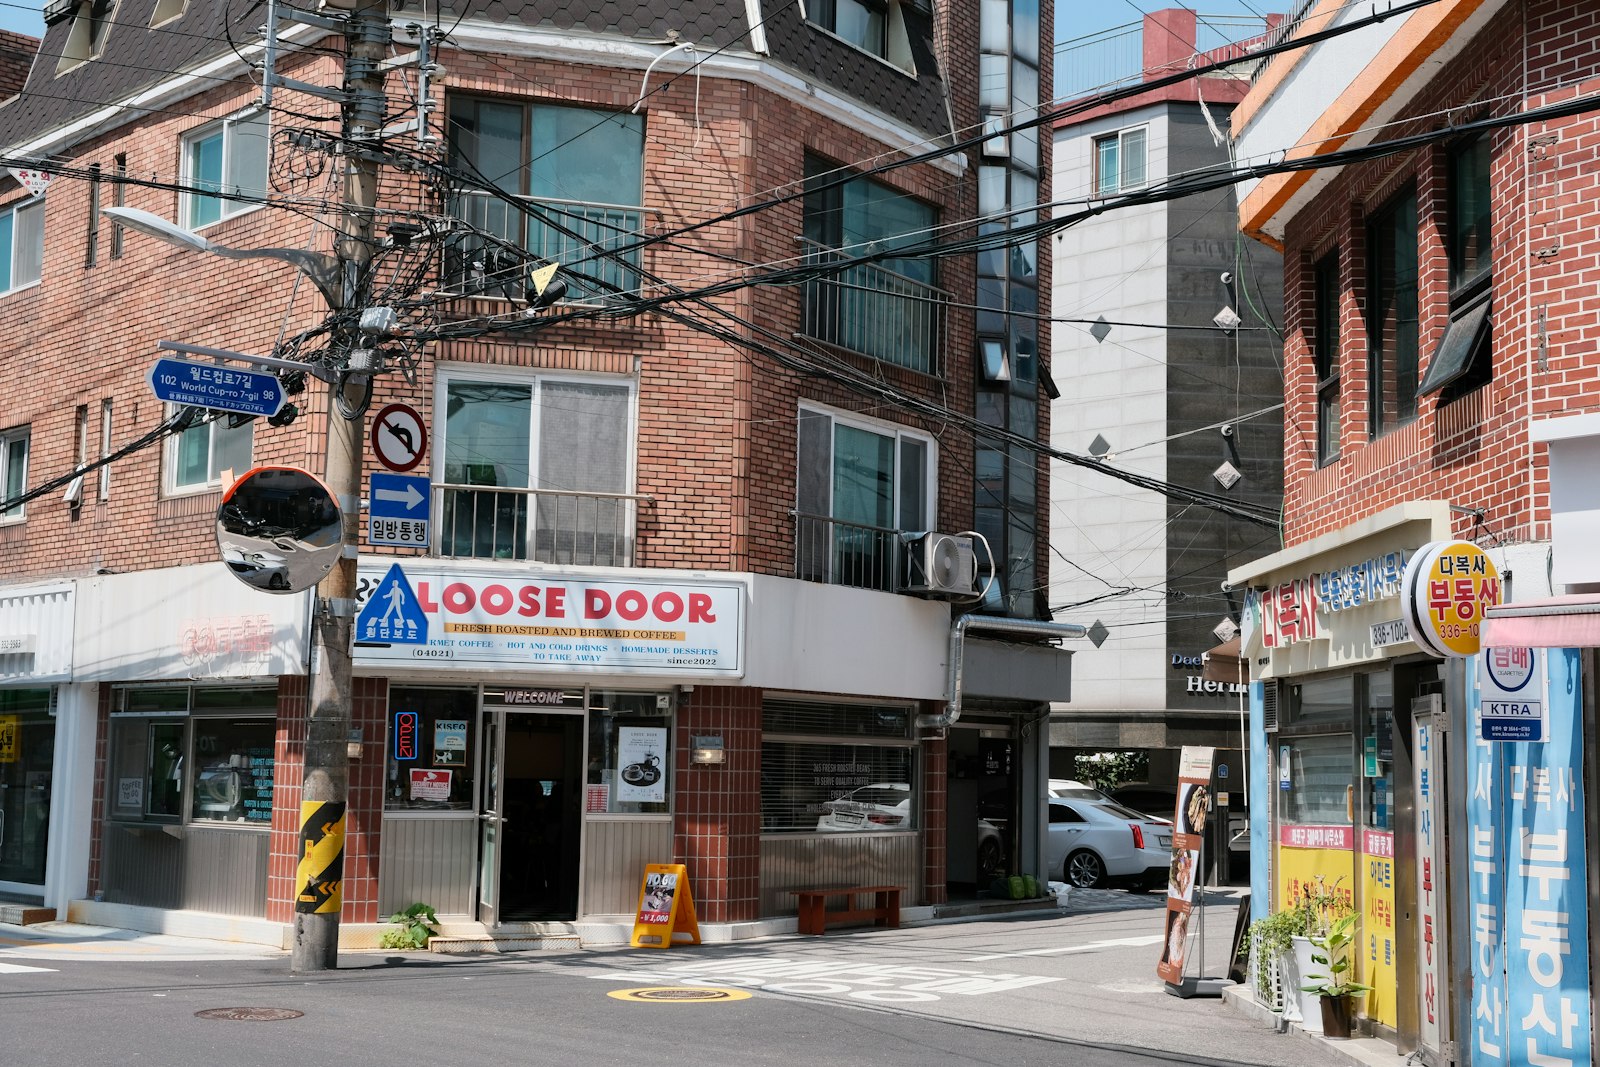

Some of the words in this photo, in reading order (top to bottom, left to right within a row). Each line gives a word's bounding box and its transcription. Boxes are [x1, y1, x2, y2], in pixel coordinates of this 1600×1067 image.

[160, 374, 177, 386] 102
[190, 366, 252, 389] 월드컵로7길
[181, 381, 207, 393] World
[208, 385, 239, 398] Cup-ro
[240, 390, 259, 402] 7-gil
[262, 390, 275, 400] 98
[373, 519, 426, 542] 일방통행
[1440, 555, 1486, 576] 다복사
[418, 581, 566, 619] LOOSE
[585, 588, 717, 624] DOOR
[1430, 578, 1499, 621] 부동산
[1262, 573, 1318, 649] 다복사
[366, 627, 418, 640] 횡단보도
[454, 624, 492, 634] FRESH
[496, 625, 549, 635] ROASTED
[552, 628, 577, 636] AND
[580, 628, 630, 638] BREWED
[633, 630, 677, 640] COFFEE
[1440, 623, 1479, 639] 336-10
[412, 648, 454, 658] (04021)
[458, 640, 494, 648] COFFEE
[528, 642, 546, 650] AND
[575, 644, 608, 652] DRINKS
[622, 646, 670, 654] HOMEMADE
[673, 648, 719, 656] DESSERTS
[575, 654, 602, 662] AWAY
[667, 657, 717, 666] since2022
[1171, 653, 1200, 666] Dae
[1186, 676, 1248, 693] Herm
[504, 690, 564, 704] WELCOME
[1491, 704, 1531, 716] KTRA
[400, 714, 413, 758] OPEN
[822, 764, 836, 773] FRESH
[856, 764, 870, 773] BEANS
[122, 780, 142, 791] COFFEE
[820, 776, 835, 785] SERVE
[854, 776, 869, 786] COFFEE
[1419, 725, 1431, 846] 다복사
[1510, 766, 1576, 812] 다복사
[662, 874, 676, 886] GO
[1370, 861, 1390, 888] 아파트
[1370, 897, 1391, 928] 사무실
[1423, 856, 1434, 1024] 부동산
[1474, 824, 1502, 1059] 부동산
[1518, 826, 1578, 1067] 부동산
